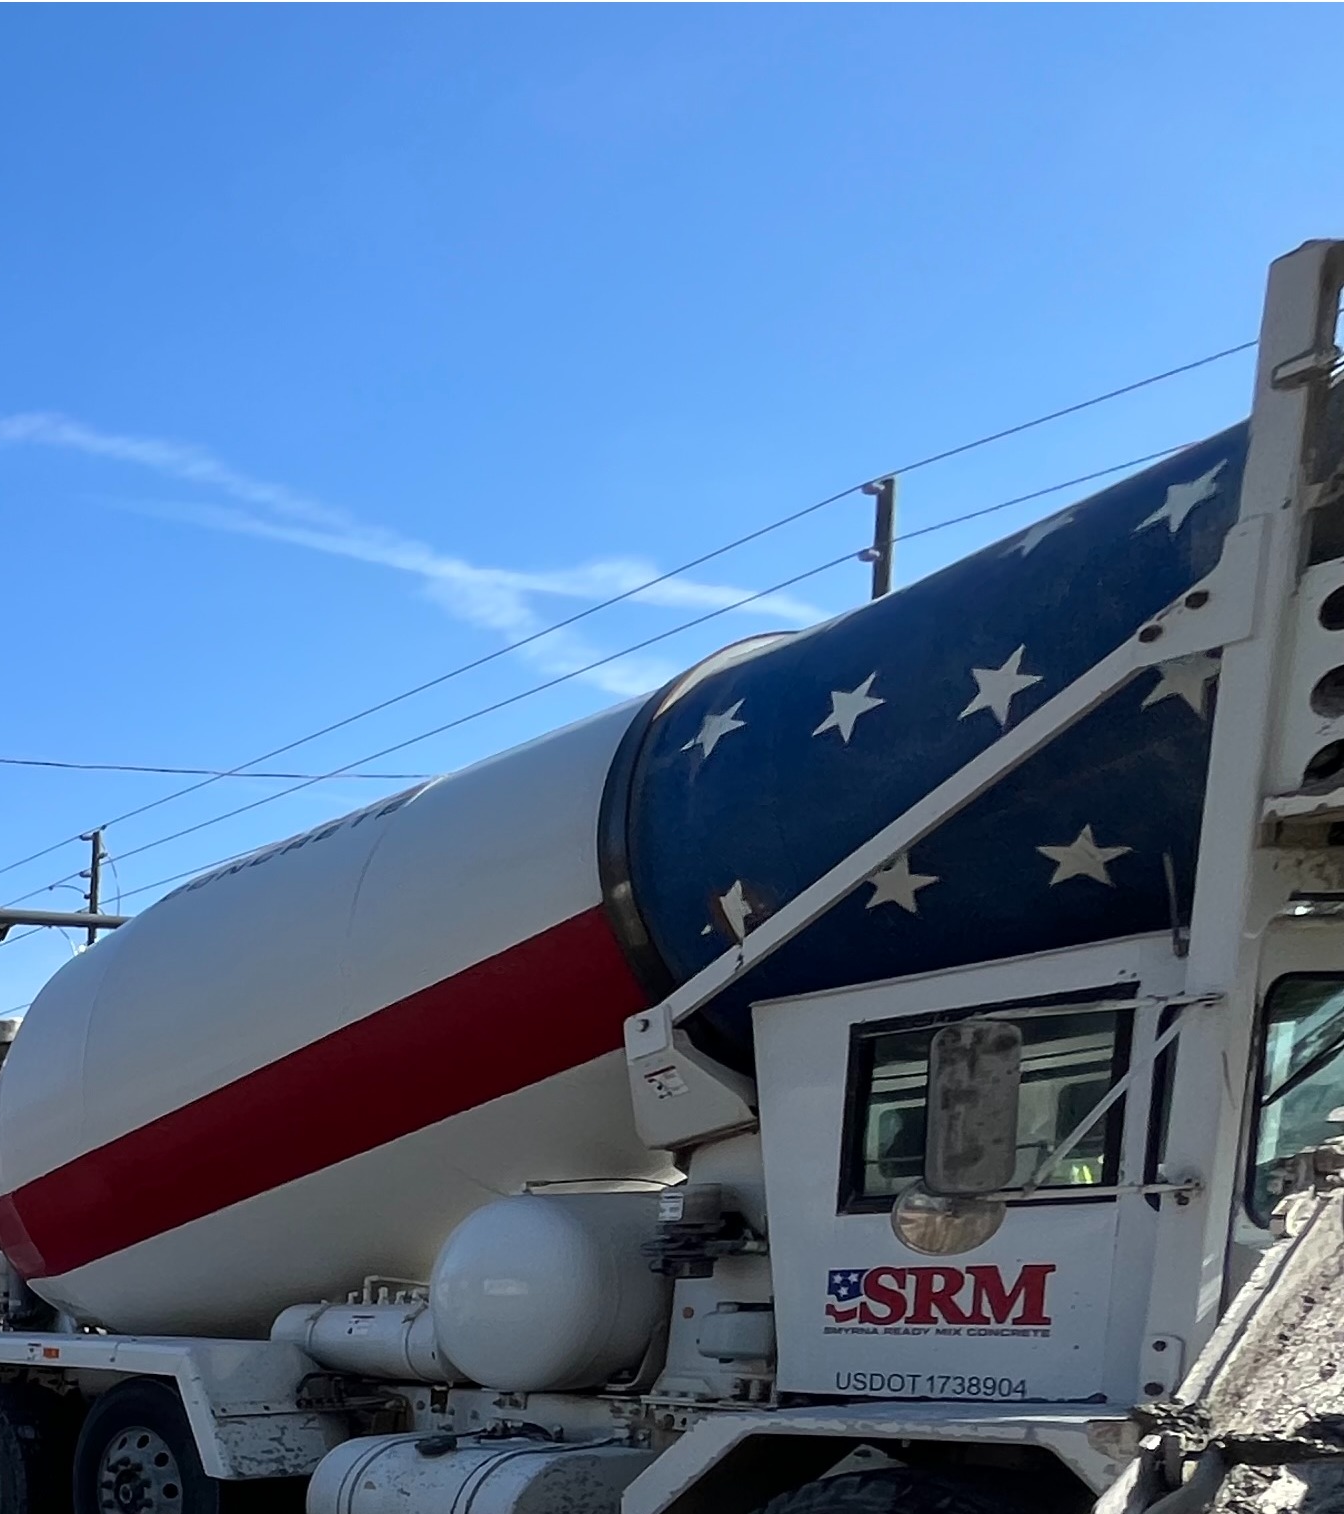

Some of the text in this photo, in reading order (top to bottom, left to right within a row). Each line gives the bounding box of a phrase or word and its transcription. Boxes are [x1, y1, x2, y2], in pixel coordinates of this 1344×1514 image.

[858, 1264, 1057, 1326] SRM
[823, 1326, 1051, 1338] SMYRNA READY MIX CONCRETE
[835, 1371, 1027, 1399] USDOT 1738904
